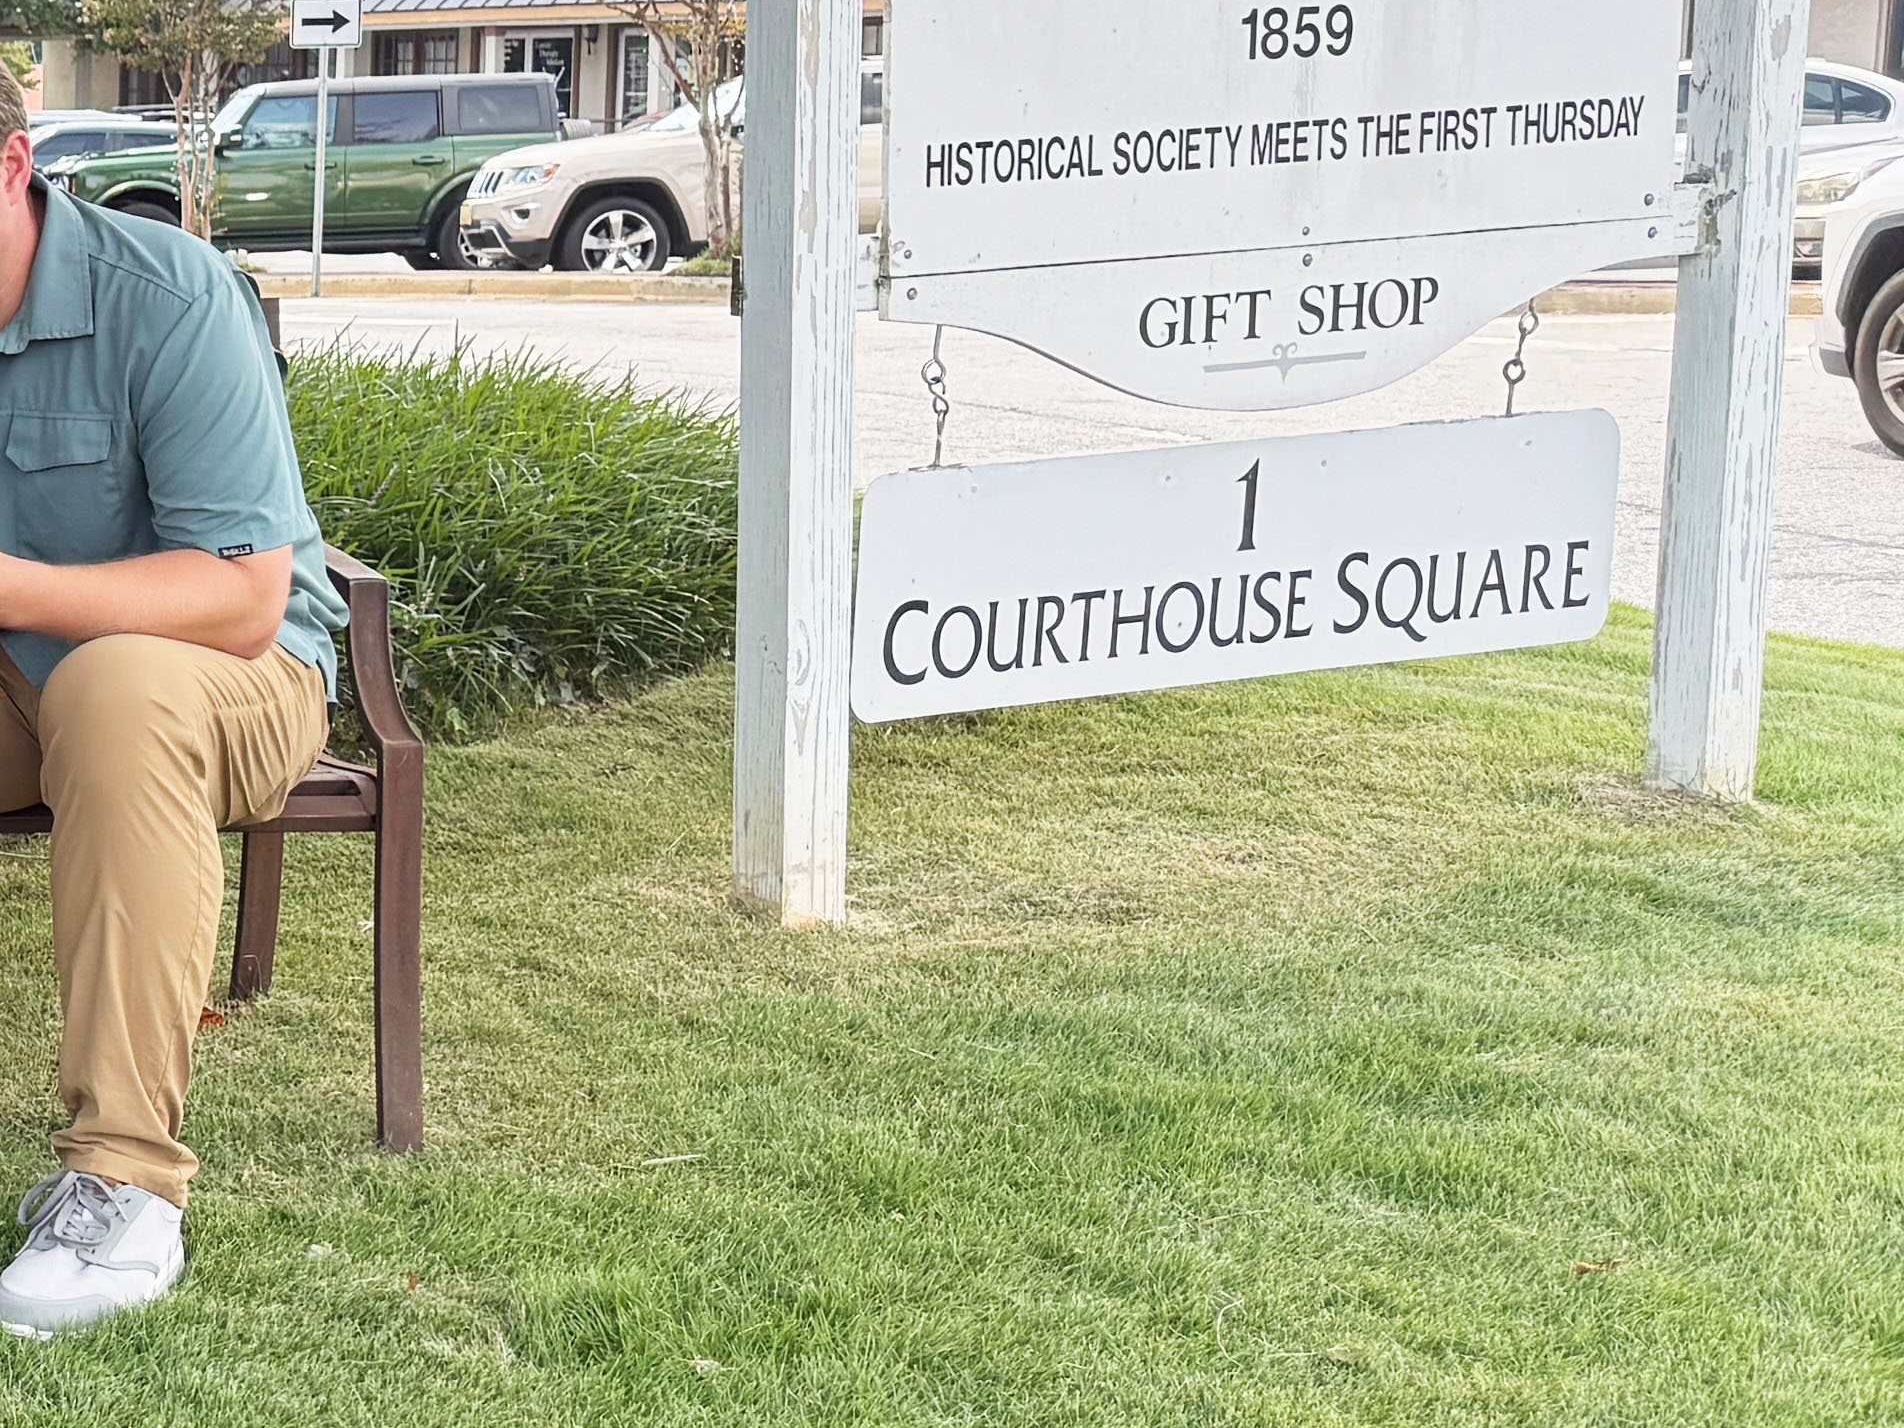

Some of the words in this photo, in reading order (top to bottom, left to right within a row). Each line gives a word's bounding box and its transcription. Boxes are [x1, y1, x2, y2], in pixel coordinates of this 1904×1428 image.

[1241, 4, 1353, 60] 1859
[926, 134, 1103, 188] HISTORICAL
[1113, 125, 1243, 176] SOCIETY
[1250, 117, 1347, 166] MEETS
[1357, 113, 1412, 158] THE
[1419, 106, 1498, 153] FIRST
[1506, 95, 1644, 146] THURSDAY
[1139, 289, 1271, 348] GIFT
[1298, 277, 1439, 335] SHOP
[1236, 457, 1260, 551] 1
[882, 569, 1313, 686] COURTHOUSE
[1333, 540, 1590, 642] SQUARE
